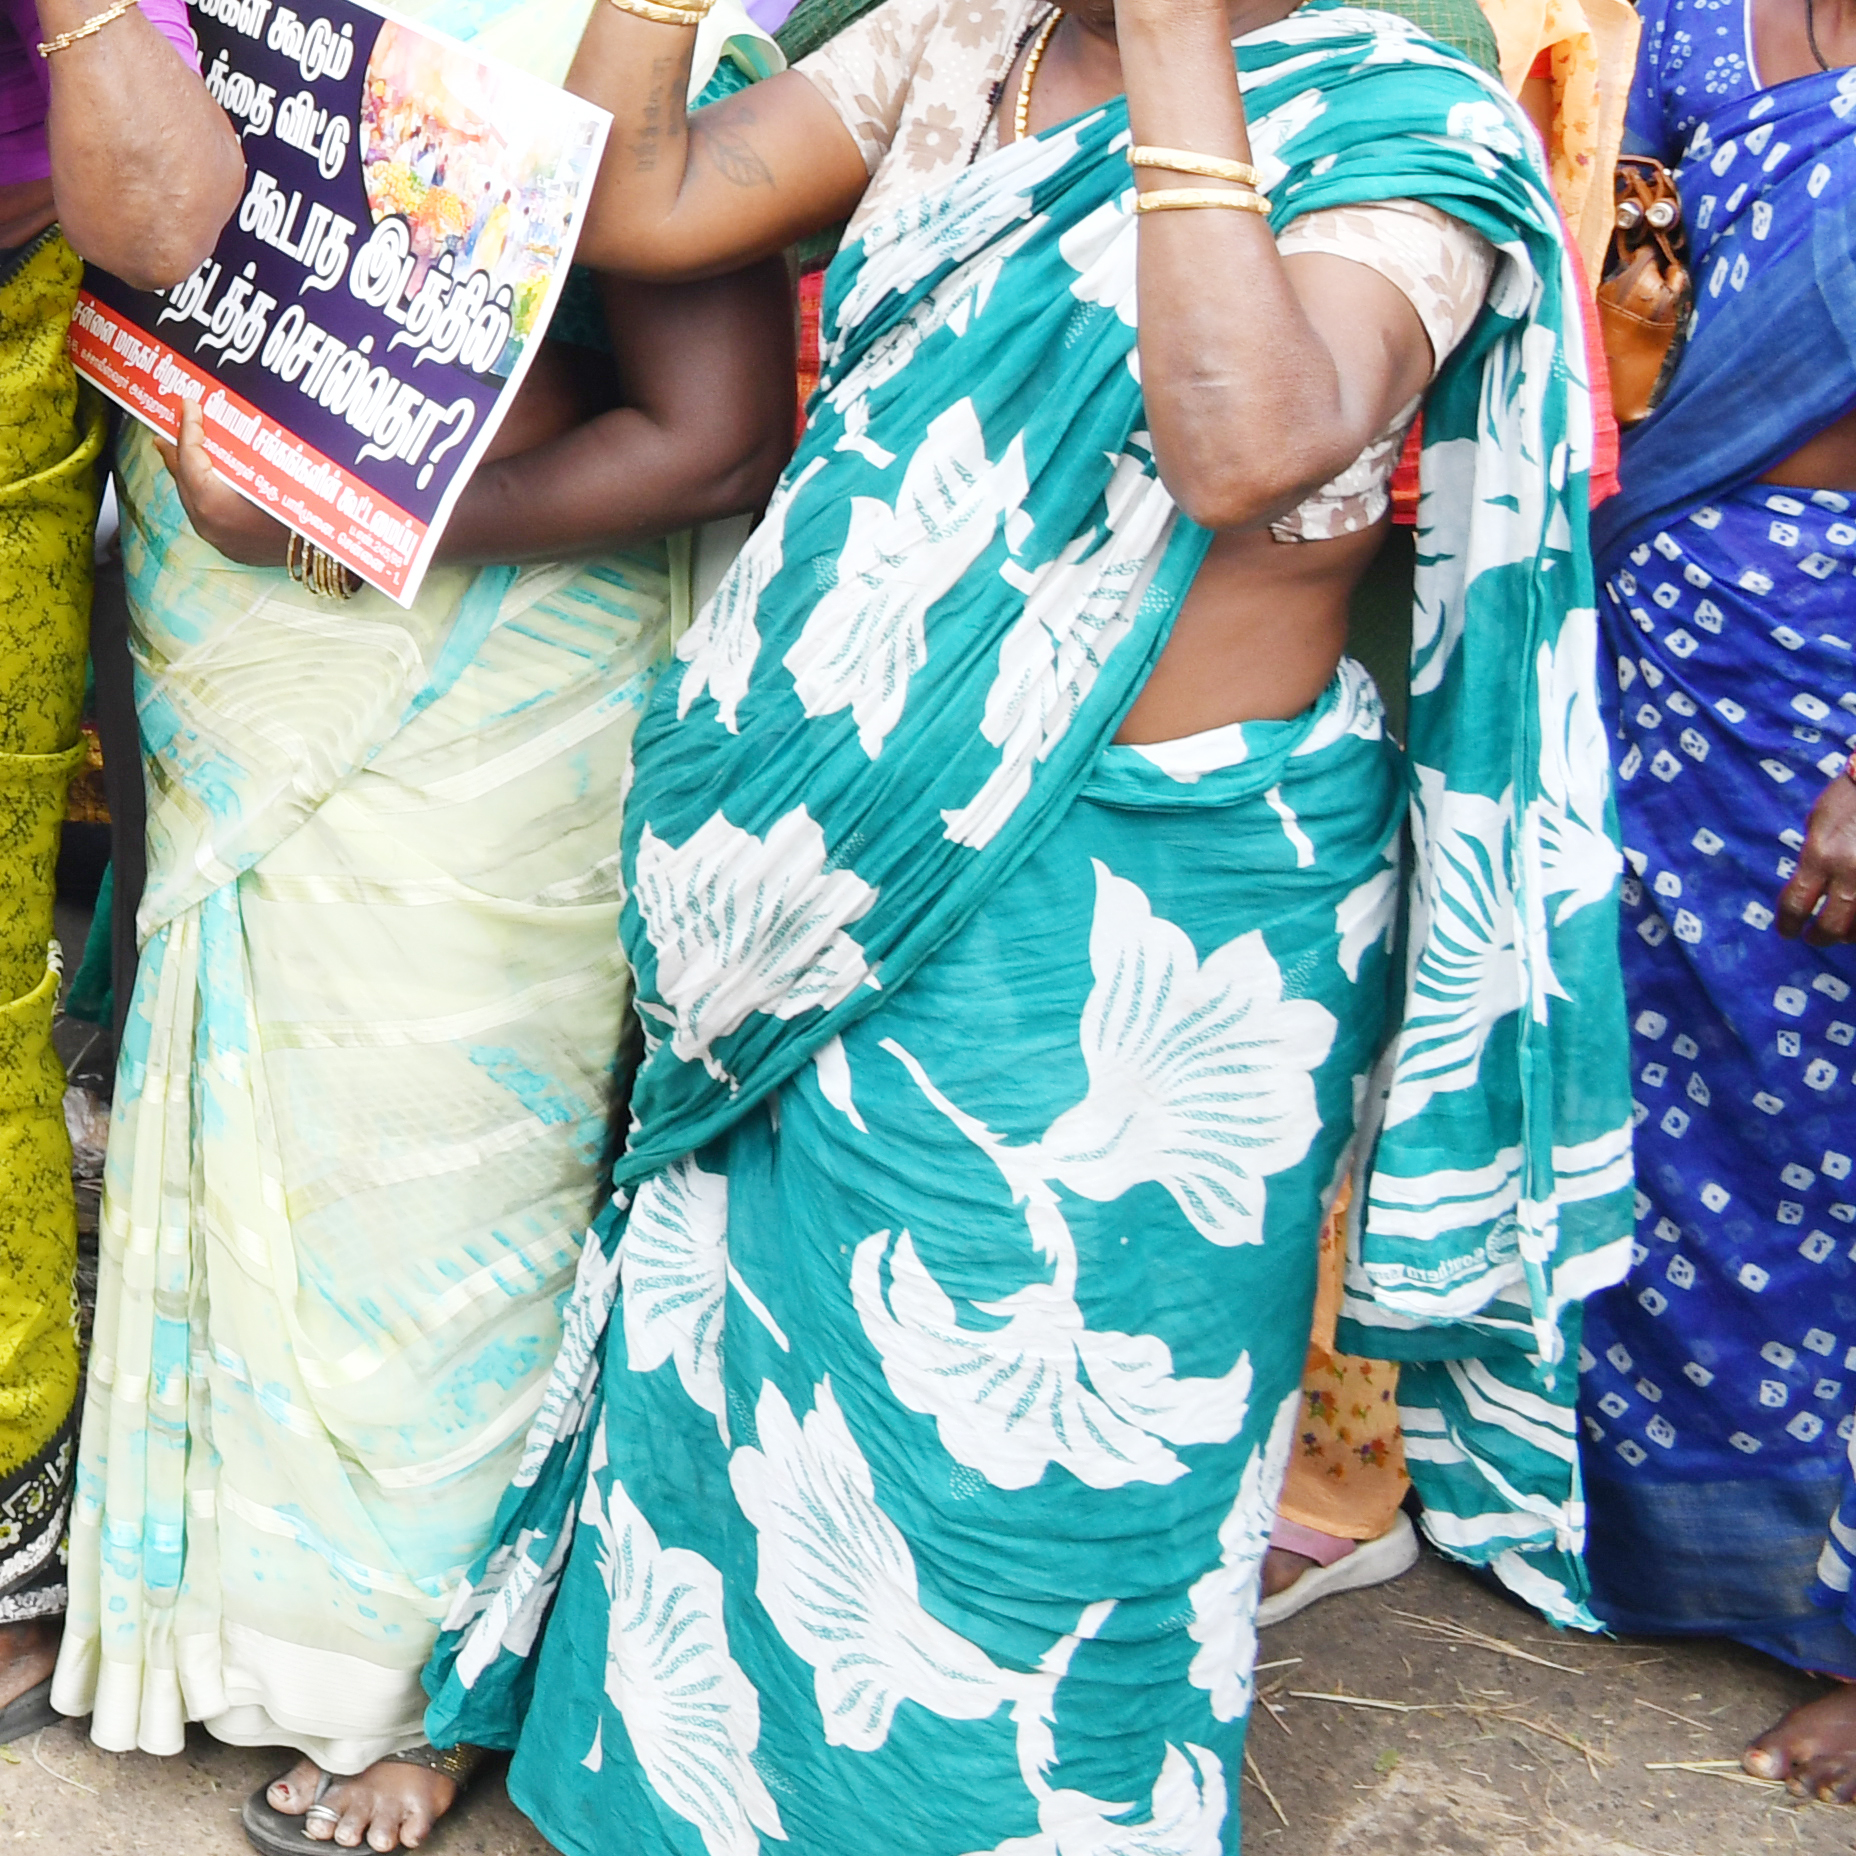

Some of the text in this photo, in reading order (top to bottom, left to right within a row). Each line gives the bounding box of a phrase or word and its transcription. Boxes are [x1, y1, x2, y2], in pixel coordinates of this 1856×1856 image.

[194, 48, 353, 181] த்தை விட்டு
[265, 7, 356, 82] கூடும்
[237, 167, 516, 377] கூடாத இடத்தில்
[275, 303, 476, 490] சொல்வதா?
